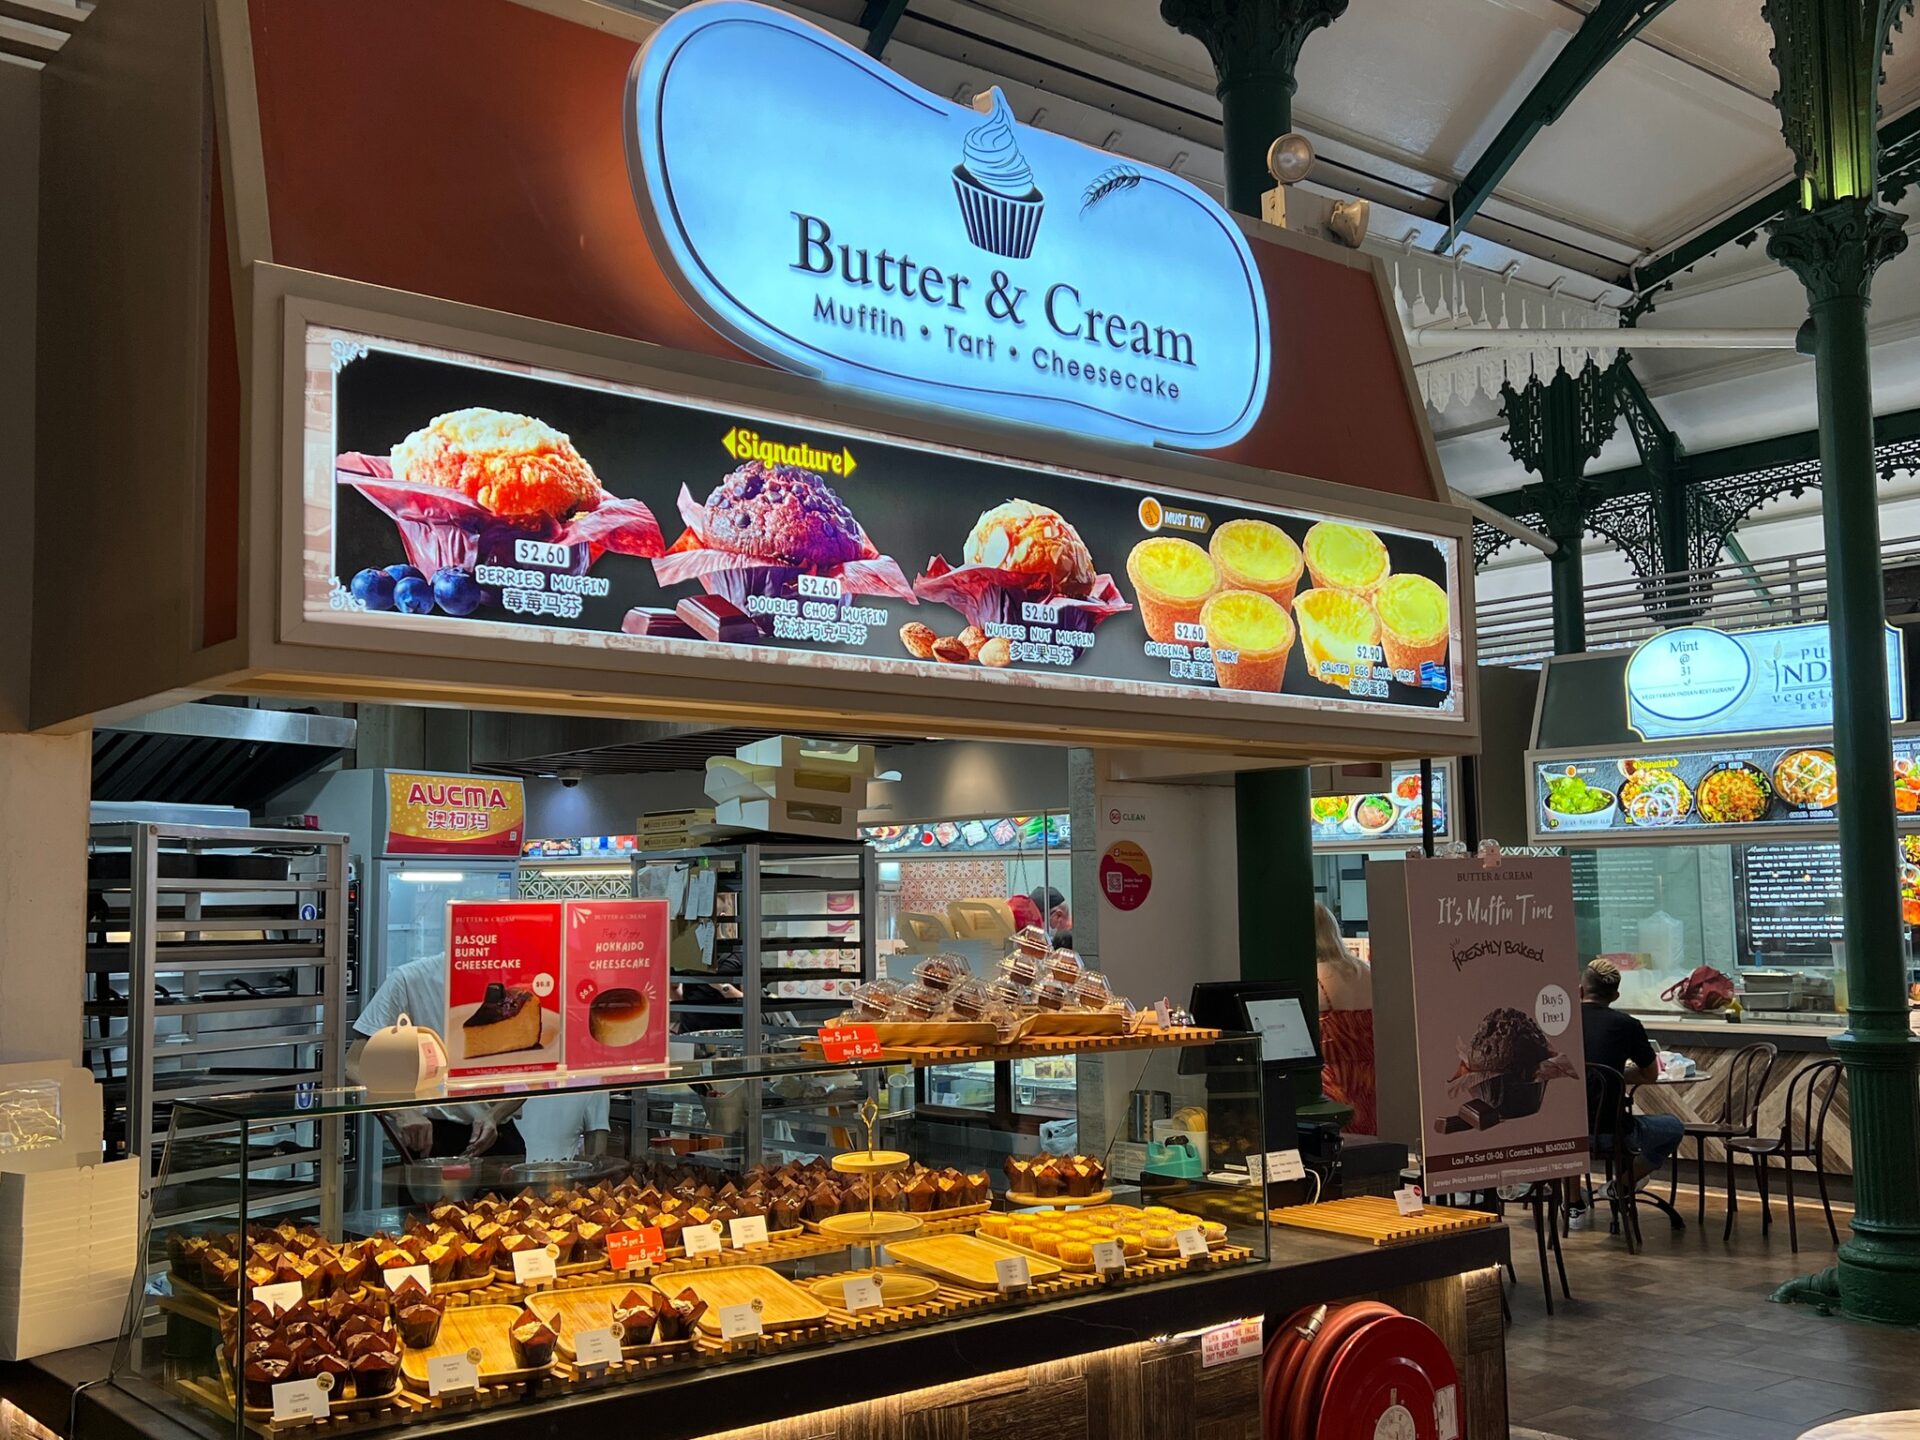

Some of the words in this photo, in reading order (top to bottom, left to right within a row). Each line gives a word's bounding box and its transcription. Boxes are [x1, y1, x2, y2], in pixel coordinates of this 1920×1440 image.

[789, 211, 969, 310] Butter
[985, 270, 1026, 325] &
[1044, 283, 1198, 366] Cream
[814, 294, 904, 338] Muffin
[944, 325, 995, 357] Tart
[1033, 348, 1180, 399] Cheesecake
[737, 430, 842, 473] Signature
[1165, 511, 1187, 526] MUST
[1189, 515, 1206, 529] TRY
[520, 542, 565, 565] $2.60
[477, 567, 544, 588] BERRIES
[552, 575, 608, 595] MUFFIN
[802, 578, 838, 596] $2.60
[505, 589, 581, 617] 莓莓马芬
[750, 597, 797, 614] DOUBLE
[804, 604, 836, 618] CHOC
[842, 607, 887, 624] MUFFIN
[1025, 605, 1055, 621] $2.60
[1031, 628, 1051, 642] NUT
[1056, 632, 1094, 647] MUFFIN
[1177, 625, 1204, 640] $2.60
[1011, 643, 1073, 665] 多坚果马芬
[1145, 643, 1190, 658] ORIGINAL
[1193, 648, 1211, 660] EGG
[1216, 651, 1239, 664] TART
[1357, 646, 1380, 660] $2.90
[1670, 640, 1699, 654] Mint
[1680, 653, 1690, 665] @
[1321, 663, 1350, 675] SALTED
[1355, 665, 1369, 677] EGG
[1373, 667, 1392, 680] LAVA
[1395, 669, 1415, 682] TART
[1681, 665, 1691, 677] 31
[408, 783, 507, 809] AUCMA
[427, 811, 489, 830] 澳柯玛
[1122, 813, 1146, 821] CLEAN
[1457, 872, 1492, 882] BUTTER
[1494, 872, 1500, 881] &
[1502, 871, 1533, 880] CREAM
[1438, 897, 1463, 926] It's
[1467, 895, 1512, 926] Muffin
[1516, 894, 1553, 925] Time
[455, 934, 497, 946] BASQUE
[595, 940, 645, 953] HOKKAIDO
[455, 947, 490, 957] BURNT
[454, 959, 521, 970] CHEESECAKE
[589, 957, 650, 970] CHEESECAKE
[1542, 994, 1556, 1007] Buy
[1558, 994, 1564, 1005] 5
[1543, 1012, 1559, 1023] Free
[834, 1031, 841, 1041] 5
[853, 1030, 858, 1040] 1
[855, 1045, 861, 1054] 8
[872, 1043, 879, 1053] 2
[1509, 1148, 1533, 1157] Contact
[610, 1241, 621, 1249] Buy
[622, 1235, 628, 1247] 5
[639, 1233, 645, 1244] 1
[640, 1248, 646, 1259] 8
[657, 1246, 663, 1256] 2
[1206, 1343, 1219, 1353] VALVE
[1206, 1353, 1215, 1362] OUT
[1216, 1350, 1225, 1359] THE
